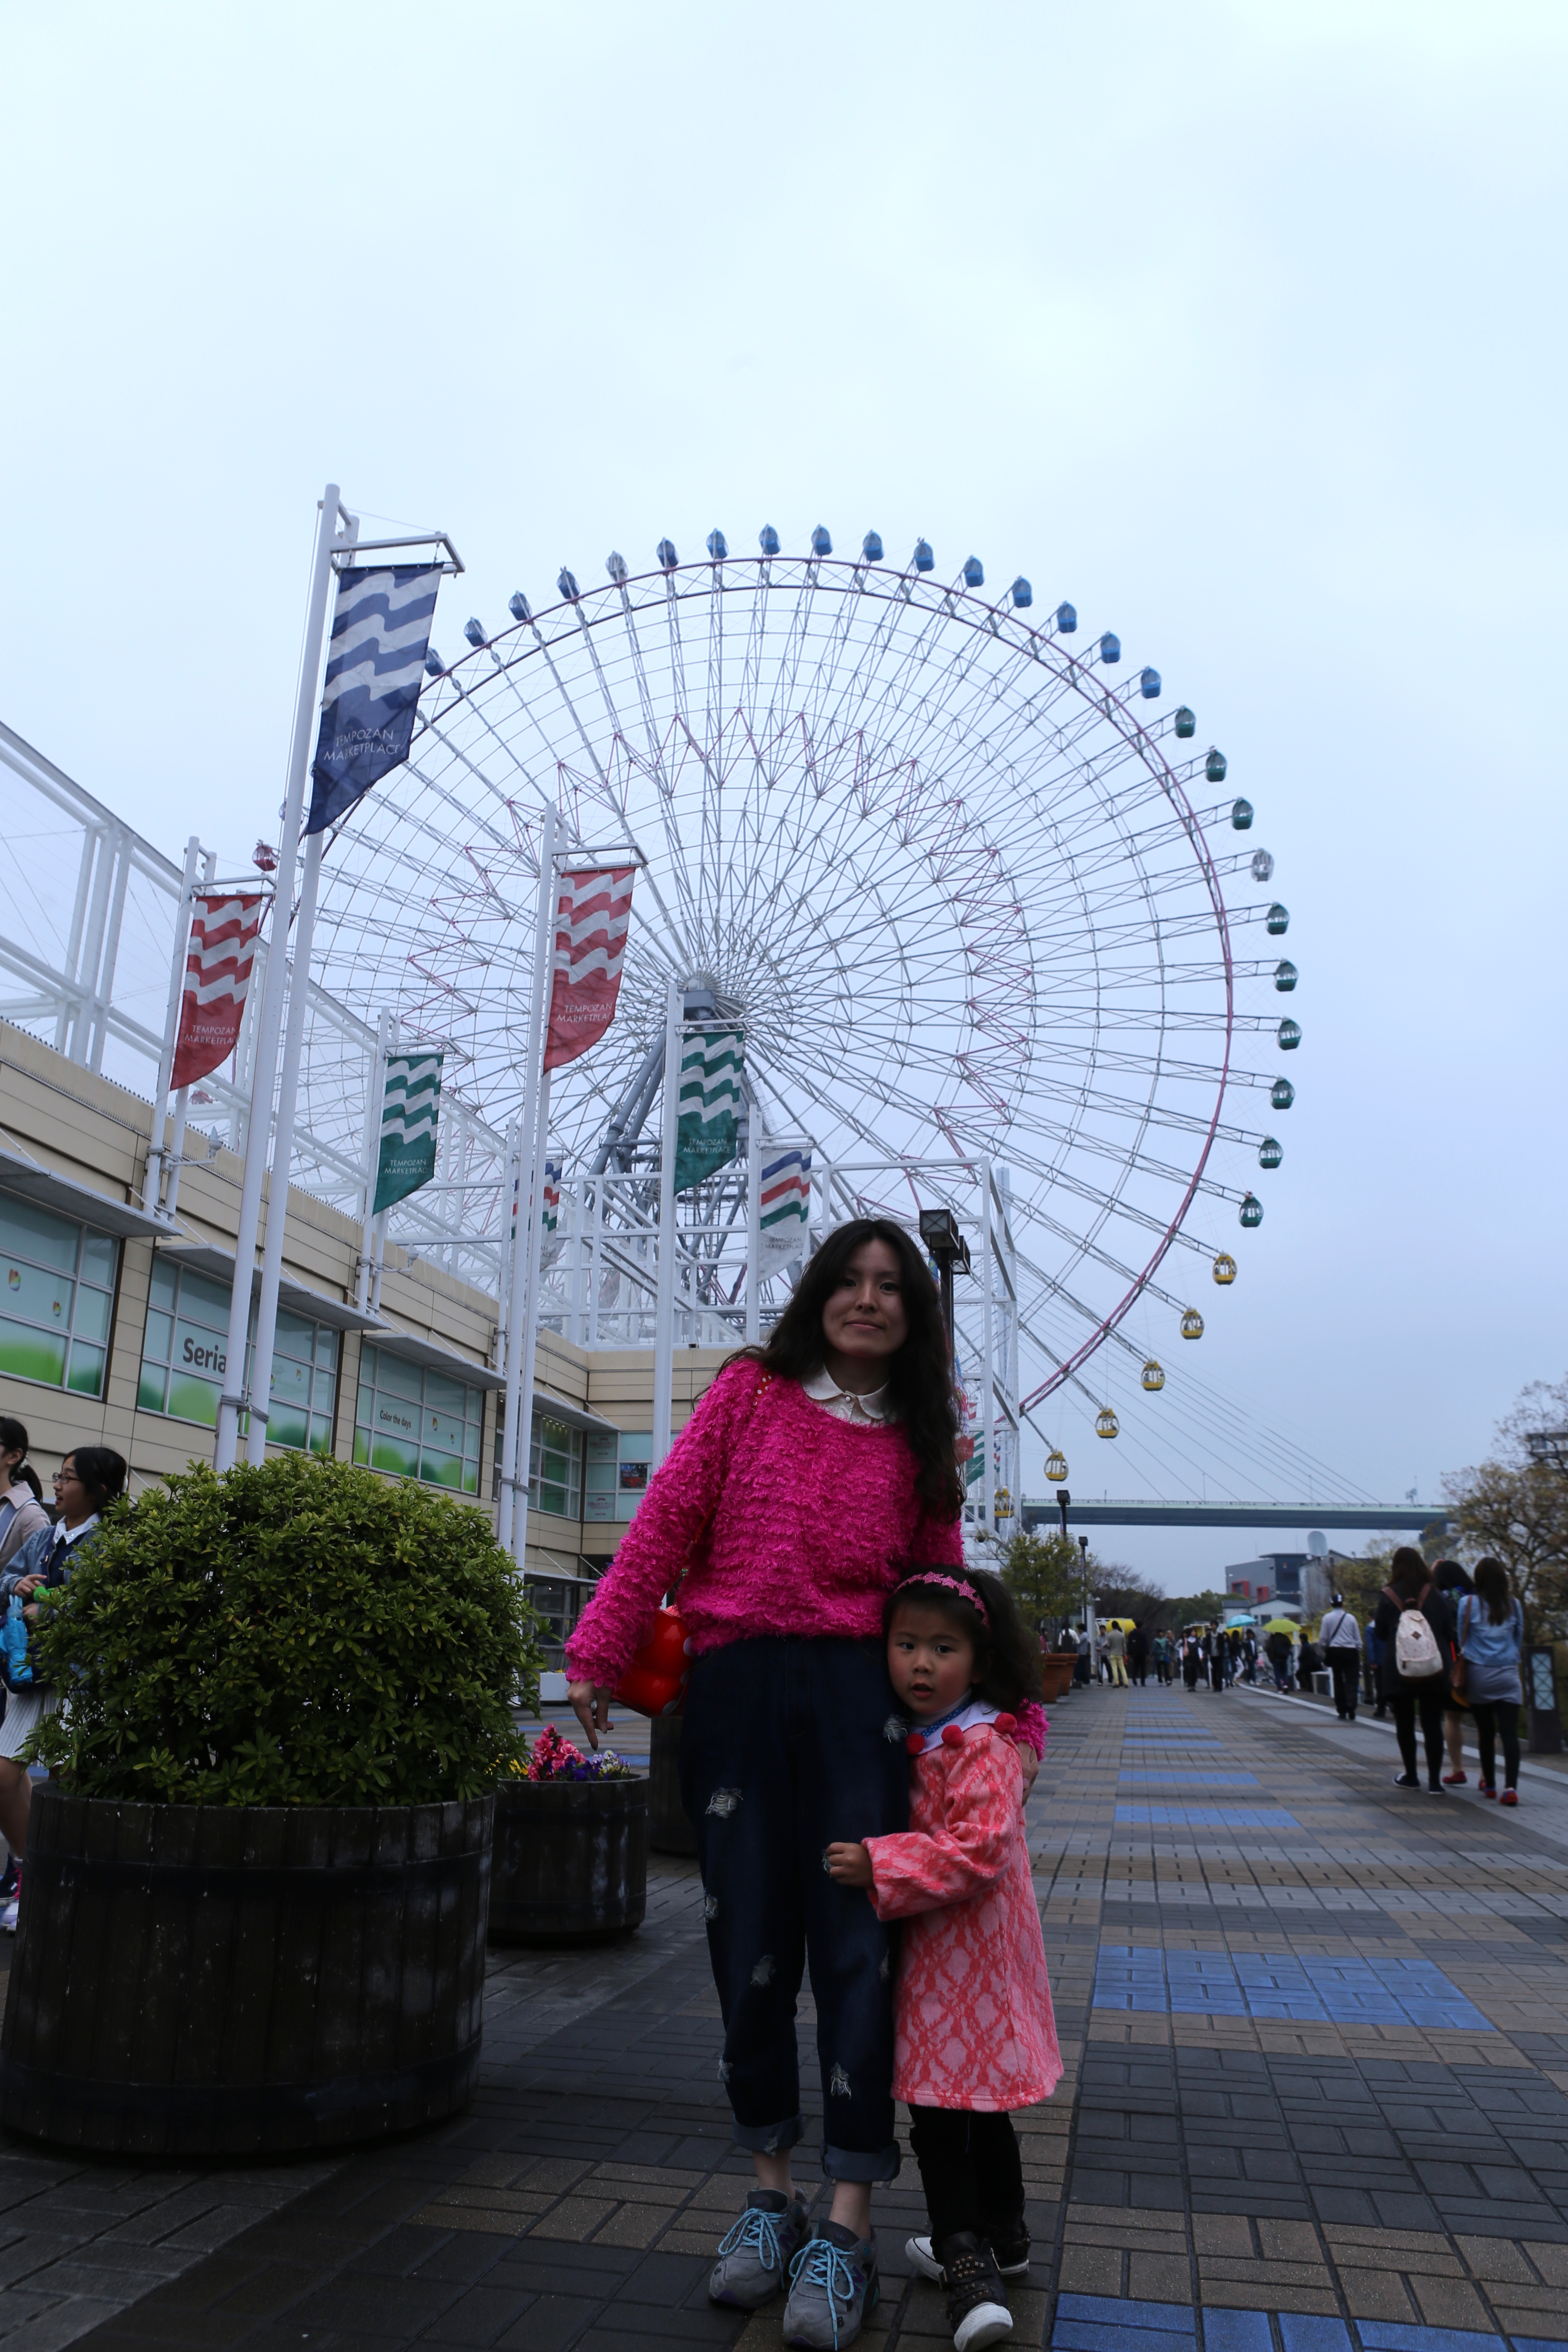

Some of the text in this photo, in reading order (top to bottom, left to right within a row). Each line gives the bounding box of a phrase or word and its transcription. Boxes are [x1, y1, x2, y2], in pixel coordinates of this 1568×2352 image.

[336, 728, 394, 747] TEMPOZAN
[565, 1002, 612, 1013] TEMPOZAN
[183, 1337, 227, 1374] Seria
[380, 1410, 392, 1422] Color
[401, 1417, 411, 1430] days
